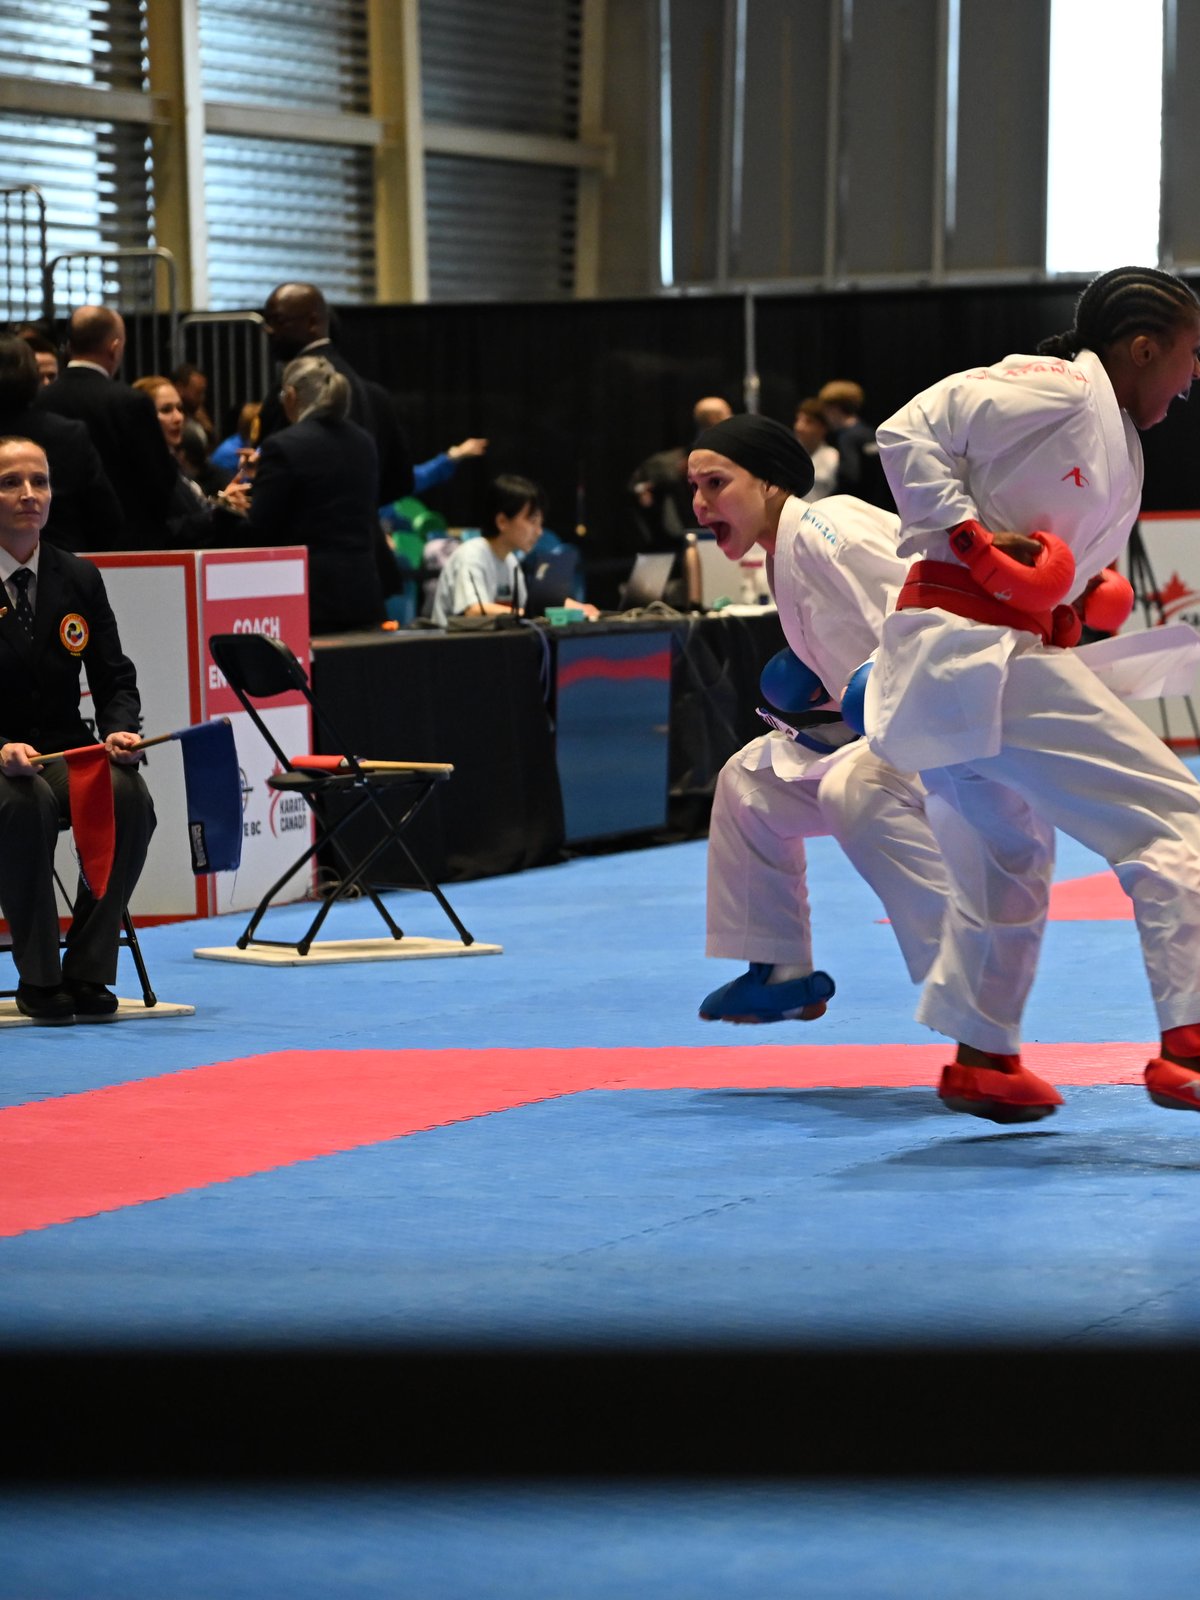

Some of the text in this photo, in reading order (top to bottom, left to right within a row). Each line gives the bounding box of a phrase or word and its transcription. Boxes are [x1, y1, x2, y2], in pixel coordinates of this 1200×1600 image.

[232, 616, 280, 639] COACH
[279, 797, 306, 814] KARATE
[250, 820, 262, 836] BC
